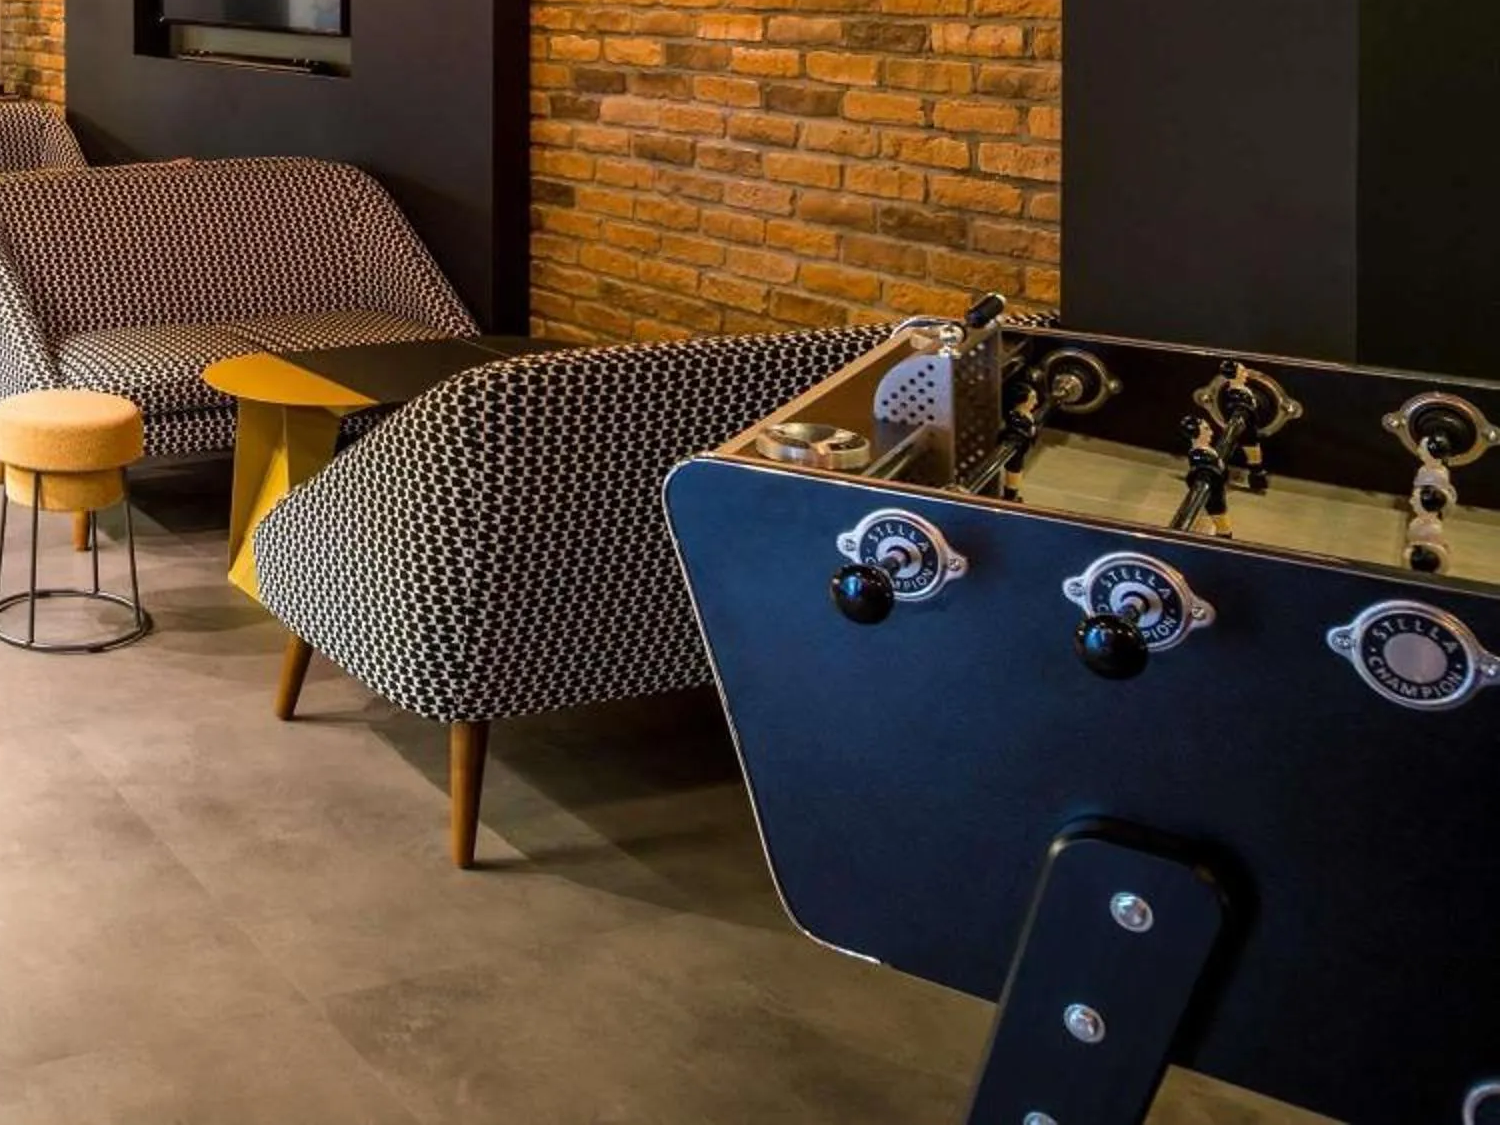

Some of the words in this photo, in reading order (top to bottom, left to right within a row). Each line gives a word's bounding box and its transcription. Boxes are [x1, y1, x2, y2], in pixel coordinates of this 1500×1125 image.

[867, 522, 930, 553] STELLA
[1100, 567, 1172, 600] STELLA
[1097, 602, 1178, 640] CPION
[1371, 618, 1458, 654] STELLA
[1367, 656, 1464, 699] CHAMPION
